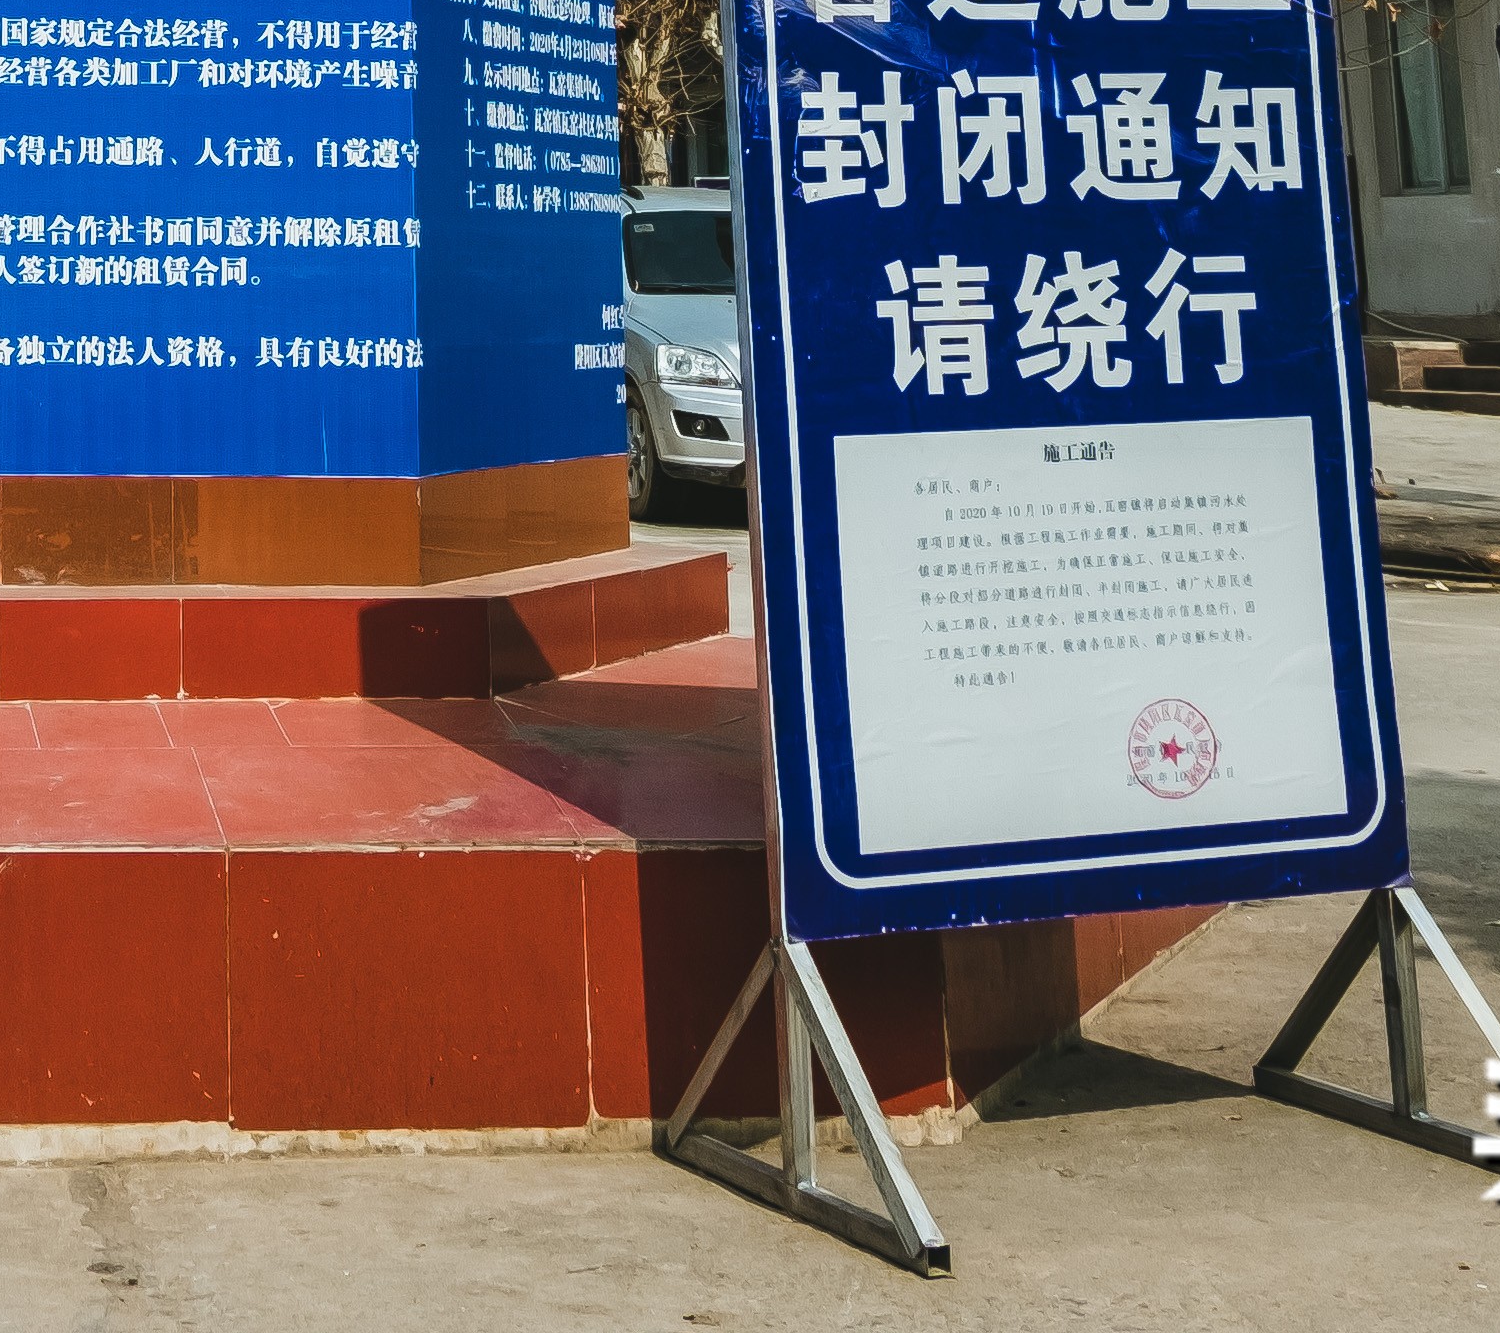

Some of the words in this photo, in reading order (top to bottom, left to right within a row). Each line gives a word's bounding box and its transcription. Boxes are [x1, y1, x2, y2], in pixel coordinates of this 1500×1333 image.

[798, 69, 1304, 210] 封闭通知
[875, 247, 1259, 398] 请绕行
[1042, 441, 1117, 464] 施工通告
